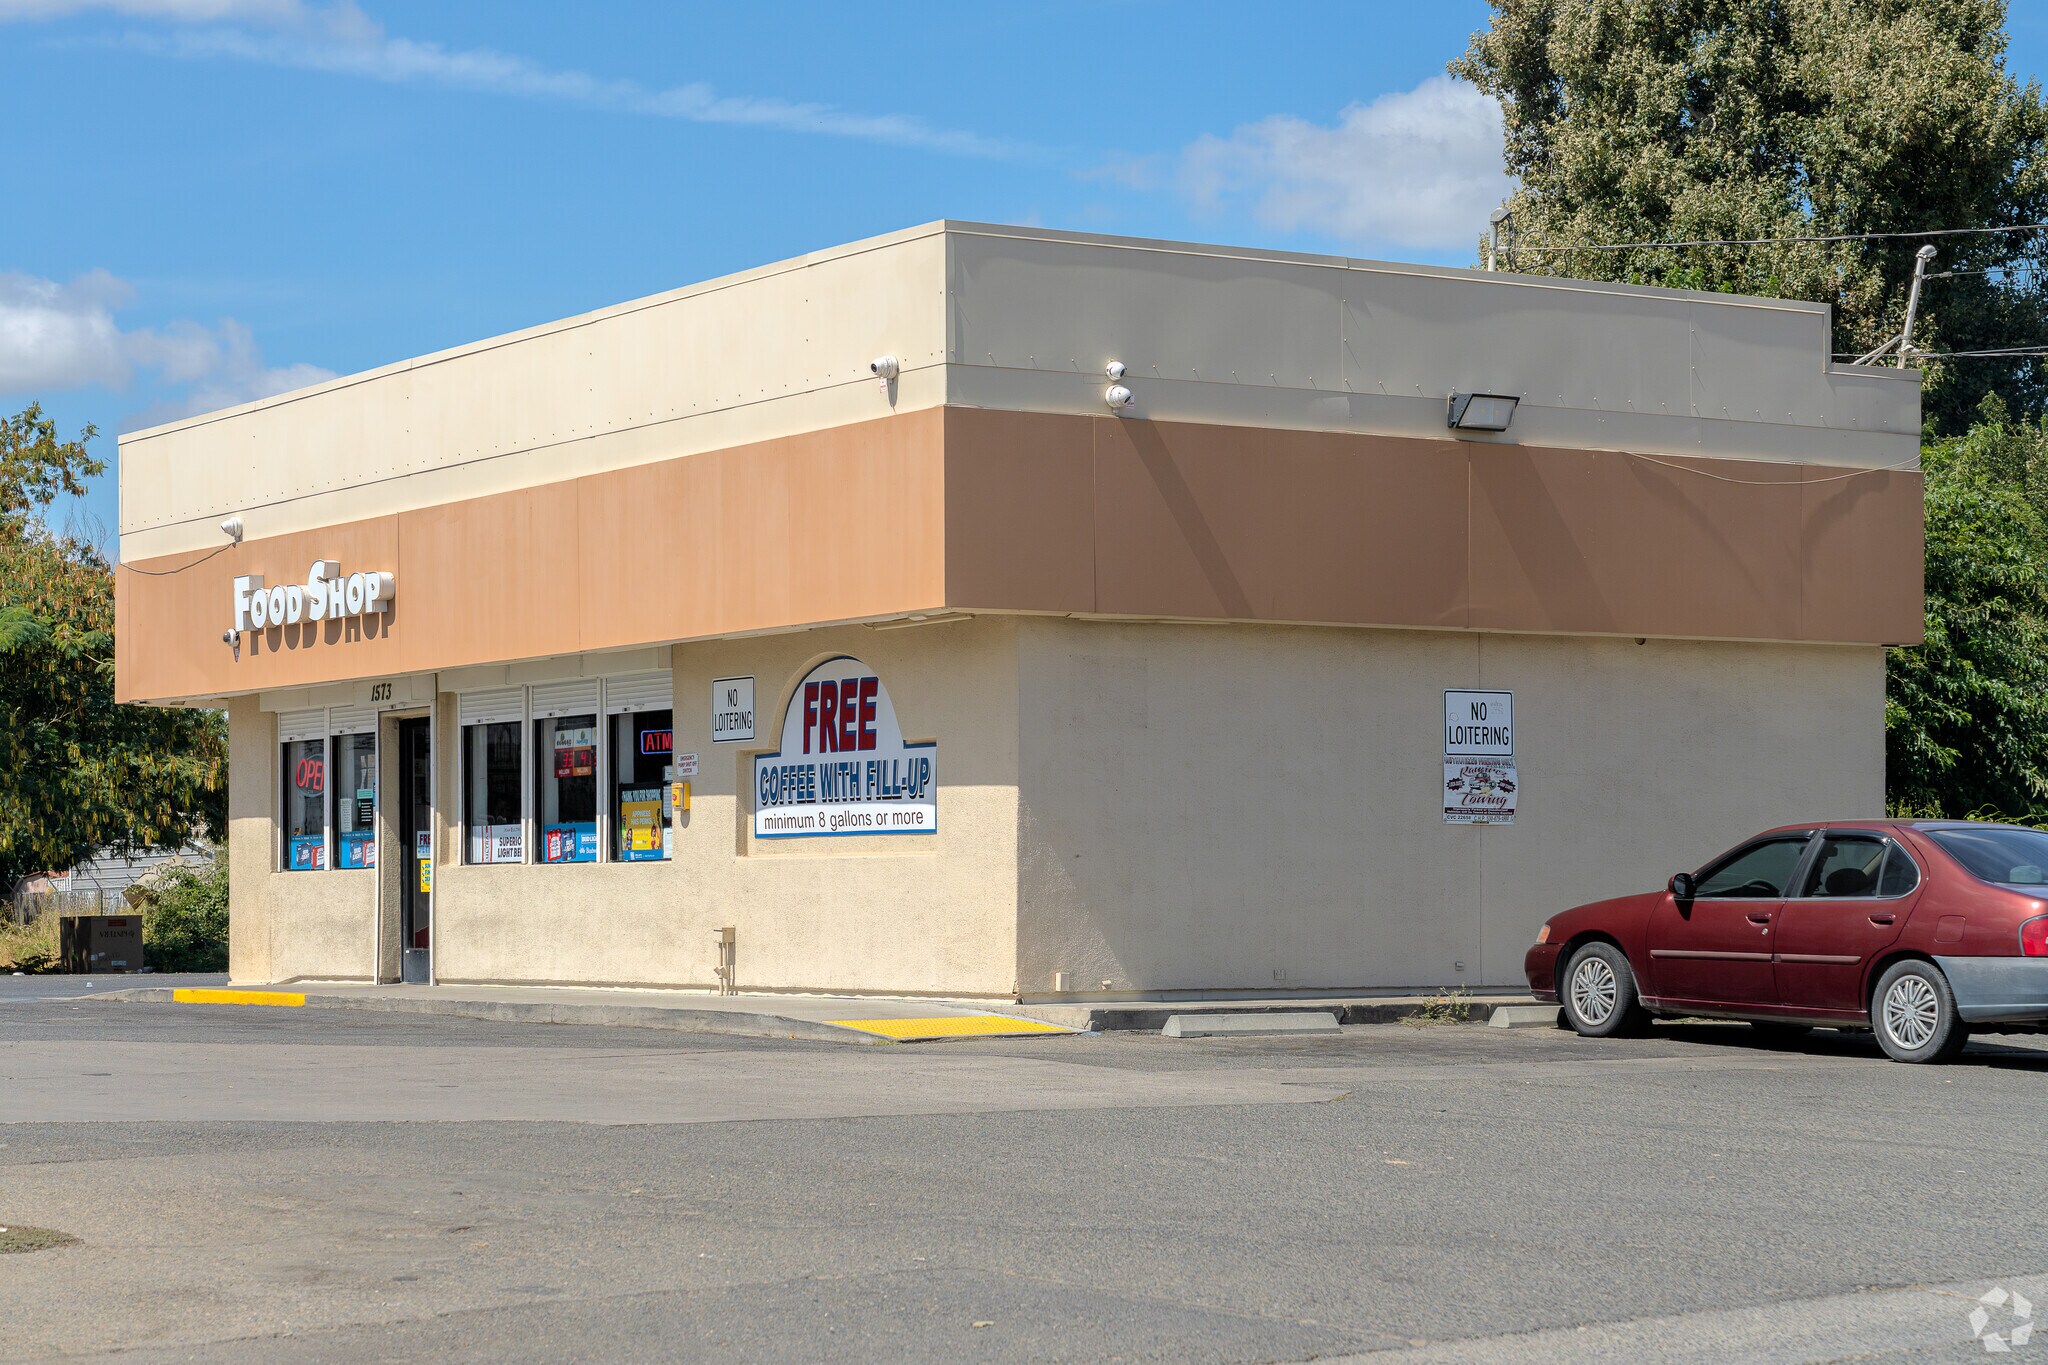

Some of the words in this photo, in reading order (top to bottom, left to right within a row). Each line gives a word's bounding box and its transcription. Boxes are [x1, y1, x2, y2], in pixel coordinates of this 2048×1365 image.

[233, 574, 303, 632] FOOD
[308, 559, 386, 622] SHOP
[371, 683, 392, 702] 1573
[727, 688, 739, 708] NO
[714, 711, 753, 733] LOITERING
[803, 676, 879, 755] FREE
[1471, 702, 1488, 721] NO
[645, 732, 672, 752] ATM
[1449, 725, 1510, 746] LOITERING
[760, 763, 817, 807] COFFEE
[819, 759, 862, 804] WITH
[866, 756, 931, 803] FILL-UP
[764, 813, 815, 830] minimum
[818, 811, 826, 828] 8
[829, 809, 872, 833] gallons
[876, 813, 888, 827] or
[892, 810, 924, 825] more
[497, 848, 513, 858] LIGHT
